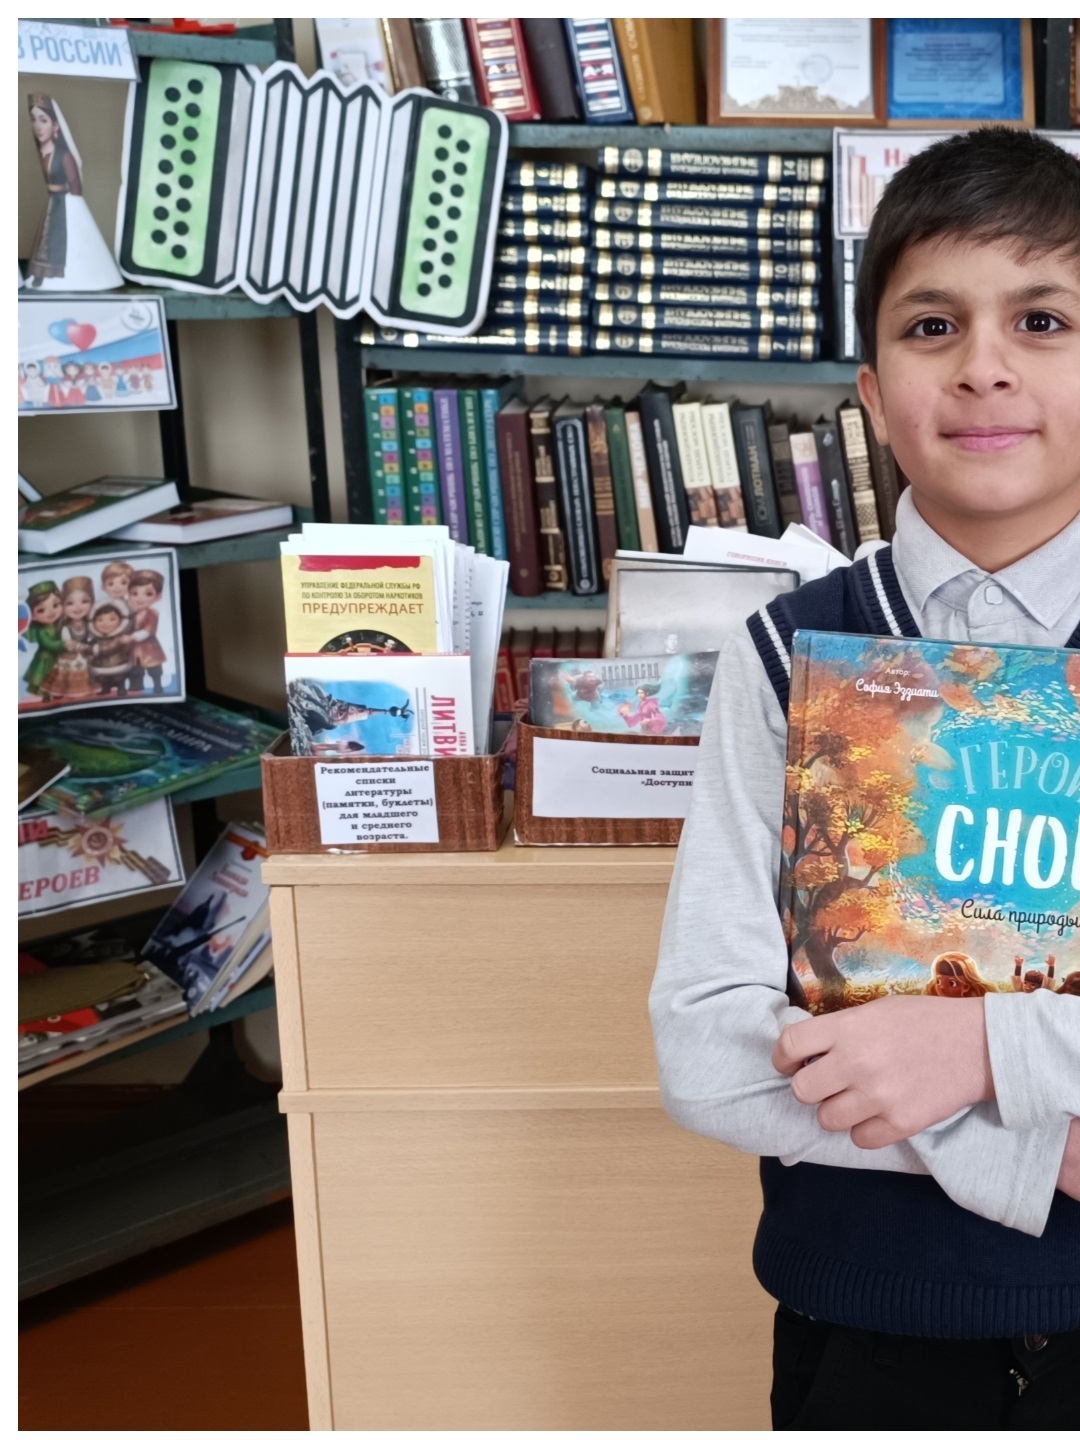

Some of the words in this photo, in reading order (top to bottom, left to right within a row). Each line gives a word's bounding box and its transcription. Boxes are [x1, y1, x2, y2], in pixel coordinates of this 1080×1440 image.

[30, 35, 122, 66] РОССИИ
[629, 422, 646, 476] ЧЕХОВА
[636, 478, 651, 509] МИР
[302, 603, 424, 615] ПРЕДУПРЕЖДАЕТ
[885, 668, 910, 677] Автор:
[856, 678, 892, 697] София
[894, 682, 939, 701] Эззиати
[321, 766, 429, 774] Рекомендательные
[592, 766, 657, 777] Социальная
[345, 789, 412, 797] литературы
[322, 801, 378, 810] (памятки,
[382, 798, 433, 808] буклеты)
[362, 821, 412, 831] среднего
[961, 898, 1005, 922] Сила
